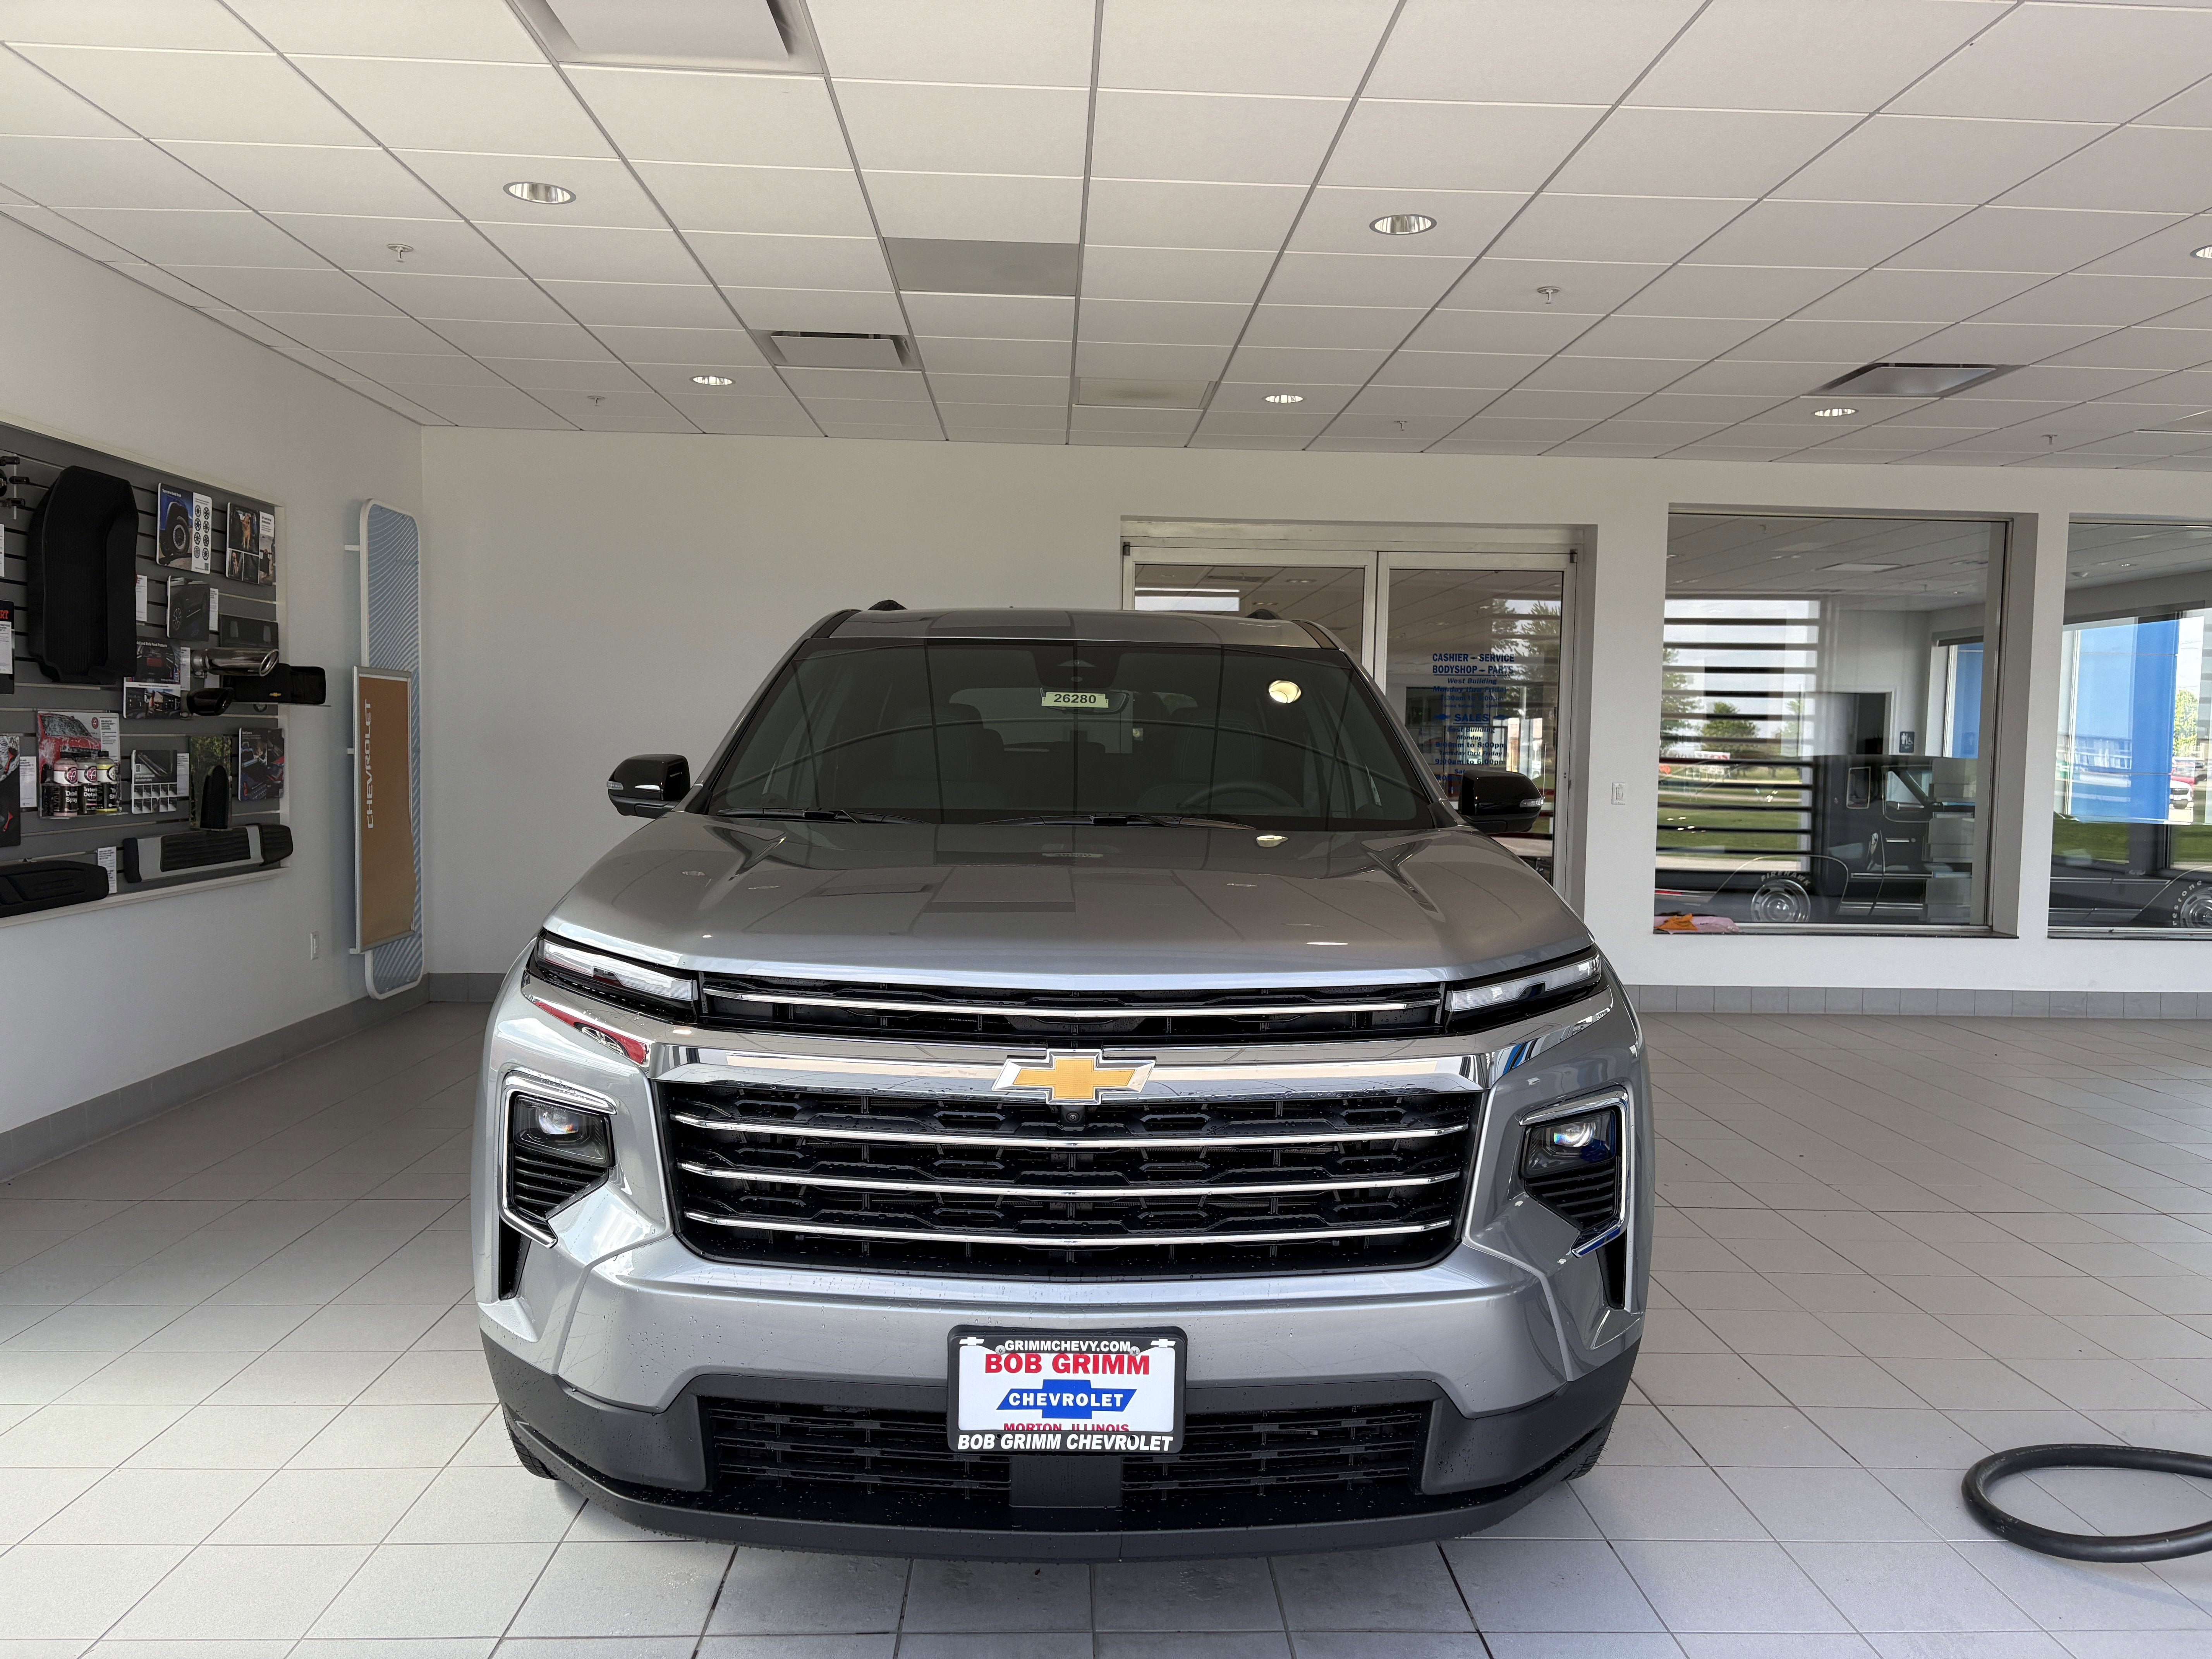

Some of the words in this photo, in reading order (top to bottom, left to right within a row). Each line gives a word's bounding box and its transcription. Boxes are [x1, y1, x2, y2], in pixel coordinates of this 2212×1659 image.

[1433, 653, 1468, 662] CASHIER
[1479, 653, 1515, 662] SERVICE
[1433, 665, 1477, 674] BODYSHOP
[1488, 665, 1514, 675] PARTS
[1053, 694, 1096, 704] 26280
[1454, 713, 1489, 722] SALES
[365, 699, 373, 828] CHEVROLET
[1761, 871, 1811, 886] FIREHAWK
[2172, 880, 2202, 926] restone
[1005, 1340, 1131, 1352] GRIMMCHEVY.COM
[985, 1353, 1042, 1373] BOB
[1052, 1353, 1149, 1375] GRIMM
[1009, 1393, 1123, 1407] CHEVROLET
[958, 1434, 995, 1449] BOB
[1000, 1434, 1061, 1449] GRIMM
[1066, 1435, 1173, 1451] CHEVROLET
